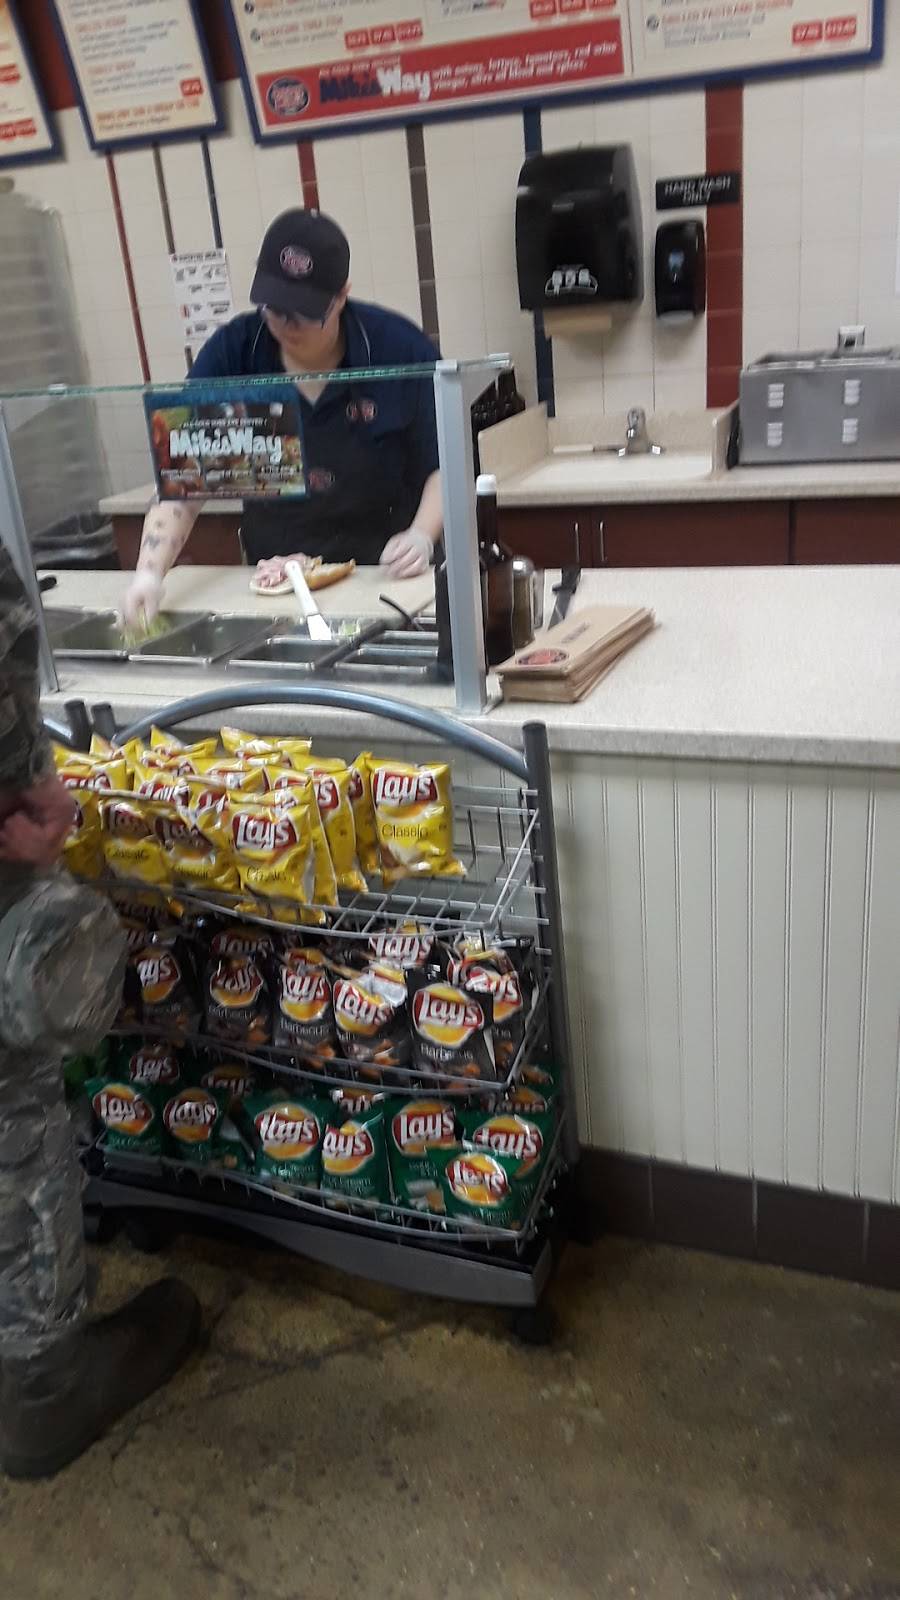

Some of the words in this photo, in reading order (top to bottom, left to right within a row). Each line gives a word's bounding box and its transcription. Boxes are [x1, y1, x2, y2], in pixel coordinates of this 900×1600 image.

[376, 65, 432, 101] Way
[665, 180, 697, 196] HAND
[700, 175, 731, 191] WASH
[683, 189, 711, 204] ONLY
